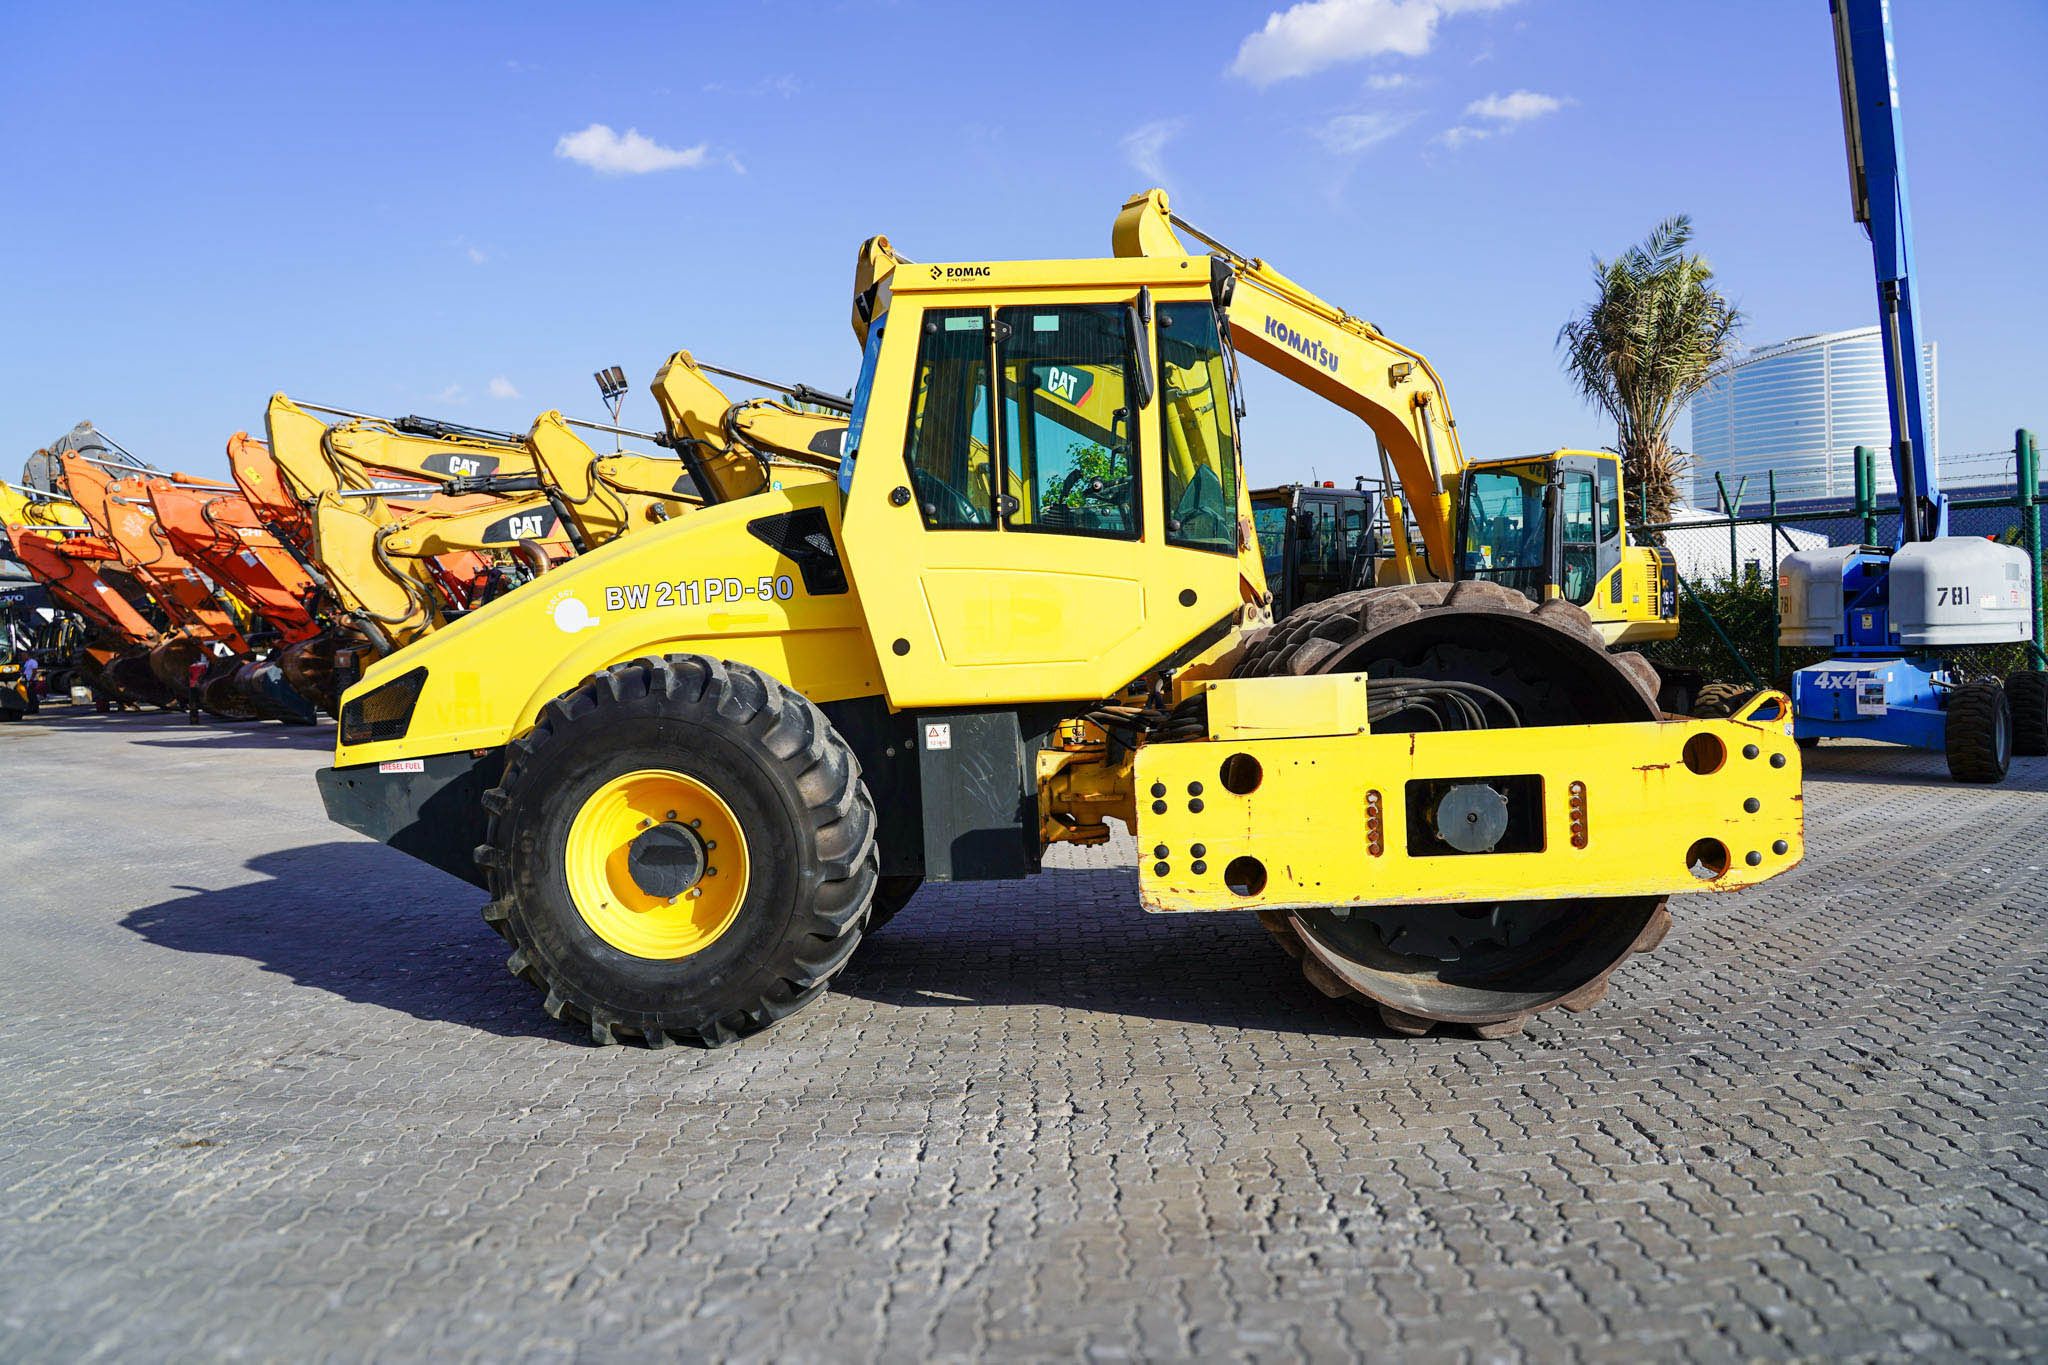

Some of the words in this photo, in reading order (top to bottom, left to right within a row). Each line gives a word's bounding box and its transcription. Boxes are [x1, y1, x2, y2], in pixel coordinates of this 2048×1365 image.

[947, 267, 990, 277] BOMAG
[1265, 314, 1339, 372] KOMATSU
[1048, 366, 1077, 400] CAT
[449, 456, 480, 477] CAT
[236, 528, 262, 536] CHI
[508, 515, 542, 539] CAT
[605, 584, 650, 611] BW
[1937, 586, 1970, 606] 781
[1814, 671, 1858, 689] 4x4
[405, 762, 422, 770] FUEL
